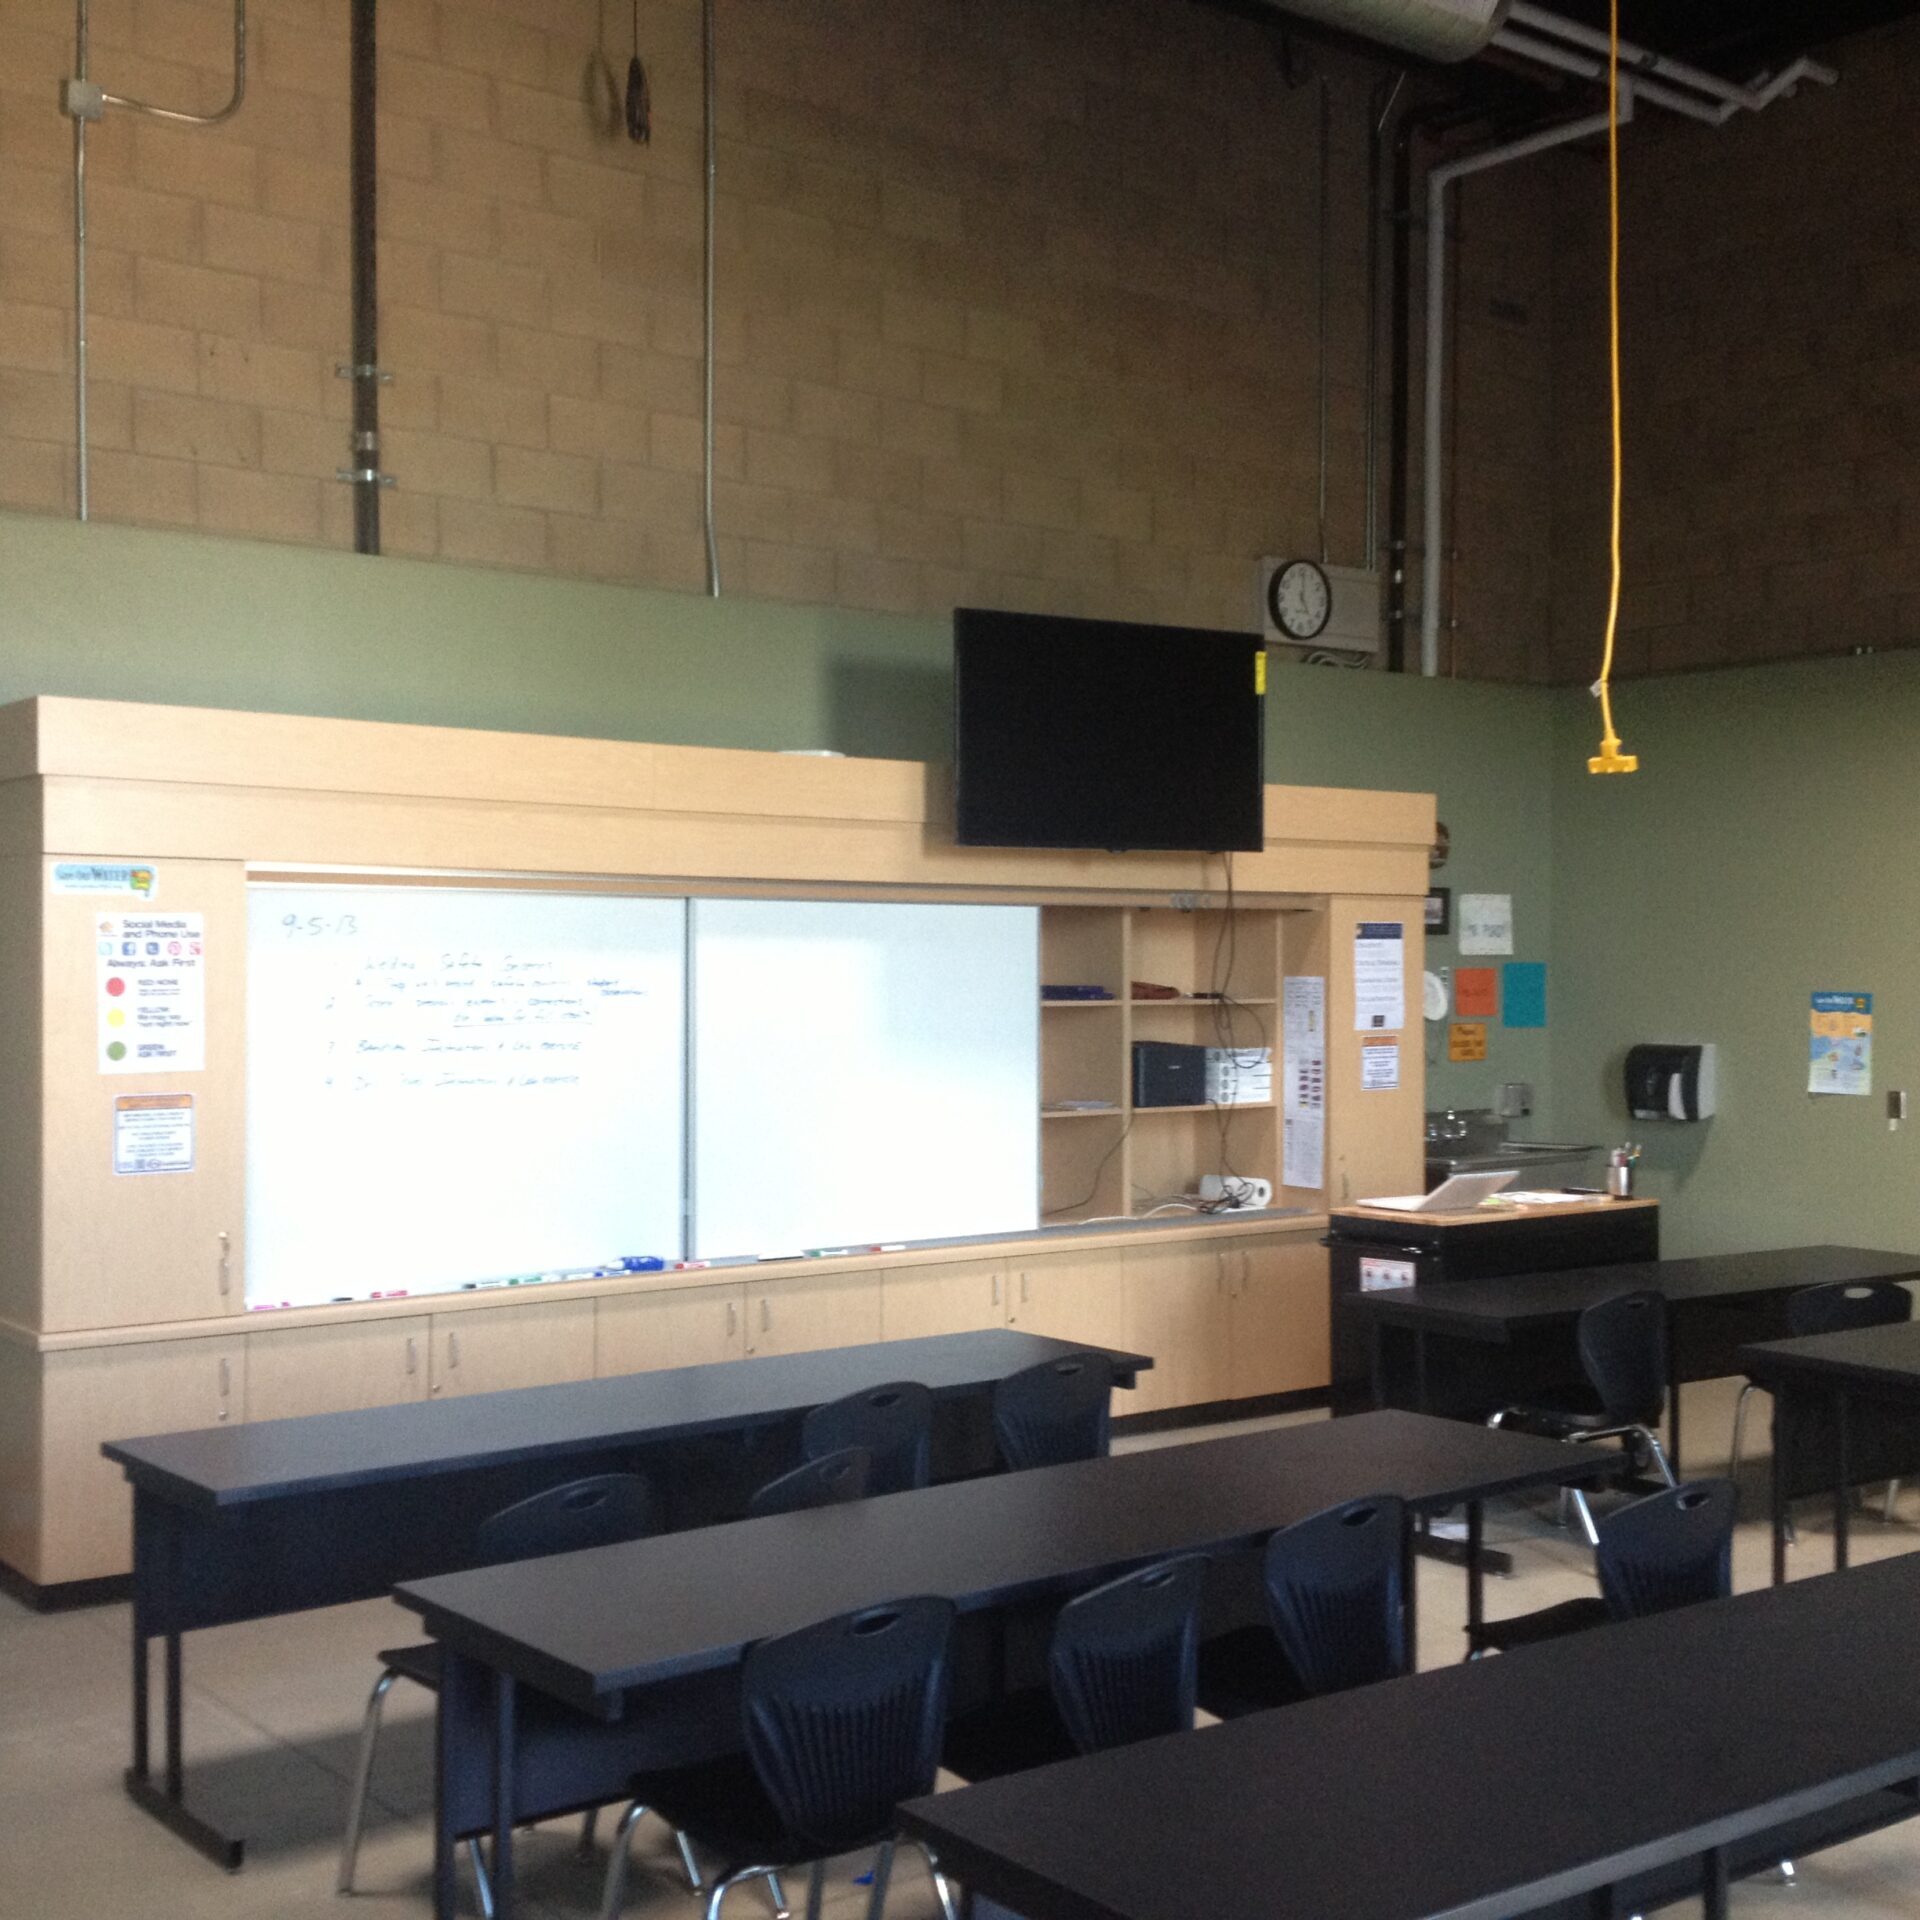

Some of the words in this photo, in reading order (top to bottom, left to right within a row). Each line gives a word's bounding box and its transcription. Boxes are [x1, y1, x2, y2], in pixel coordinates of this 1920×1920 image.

[122, 919, 153, 929] Social
[155, 920, 187, 929] Media
[122, 930, 142, 938] and
[145, 929, 178, 938] Phone
[180, 930, 201, 938] Use
[172, 958, 196, 967] First
